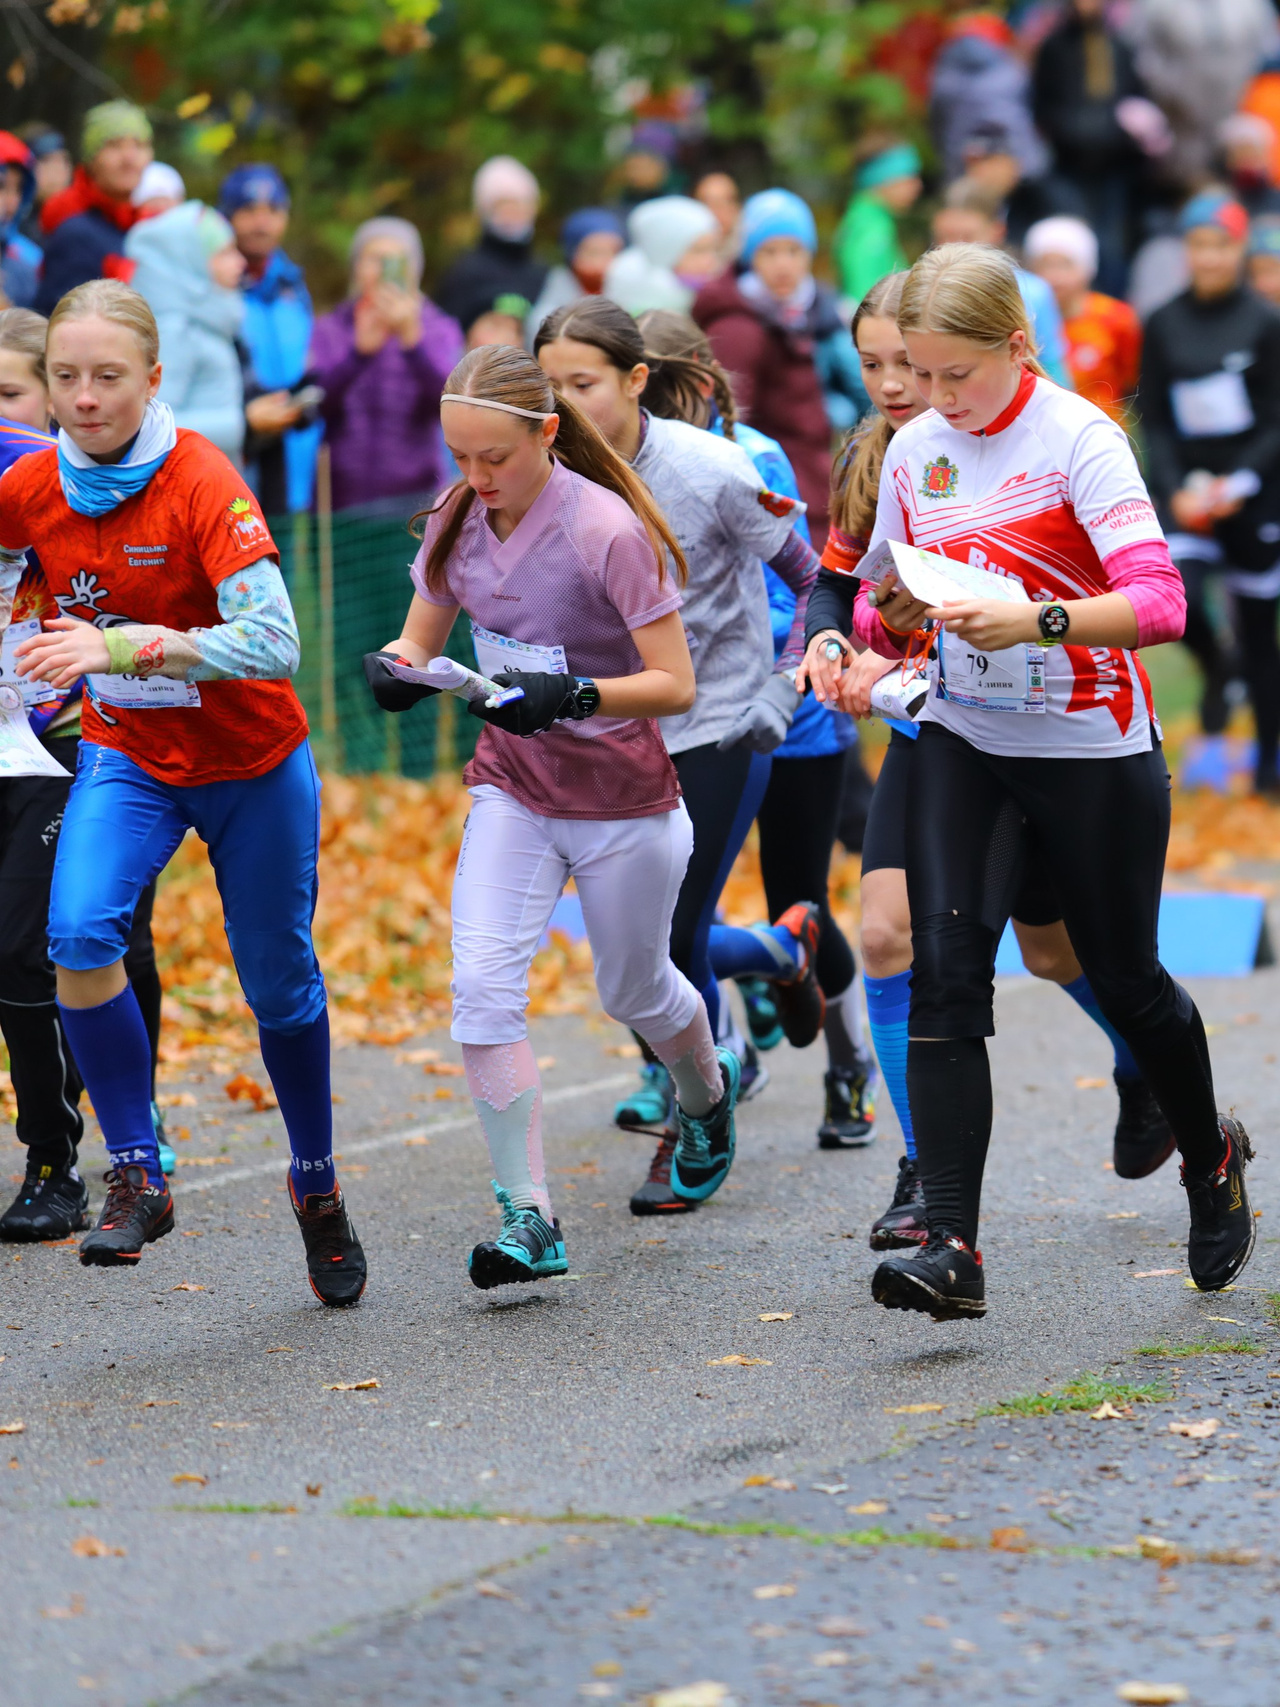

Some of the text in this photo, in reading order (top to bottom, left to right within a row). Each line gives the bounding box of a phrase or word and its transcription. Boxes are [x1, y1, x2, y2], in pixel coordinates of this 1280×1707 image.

[123, 544, 168, 553] Синицына
[128, 557, 165, 566] Евгения
[967, 653, 988, 676] 79
